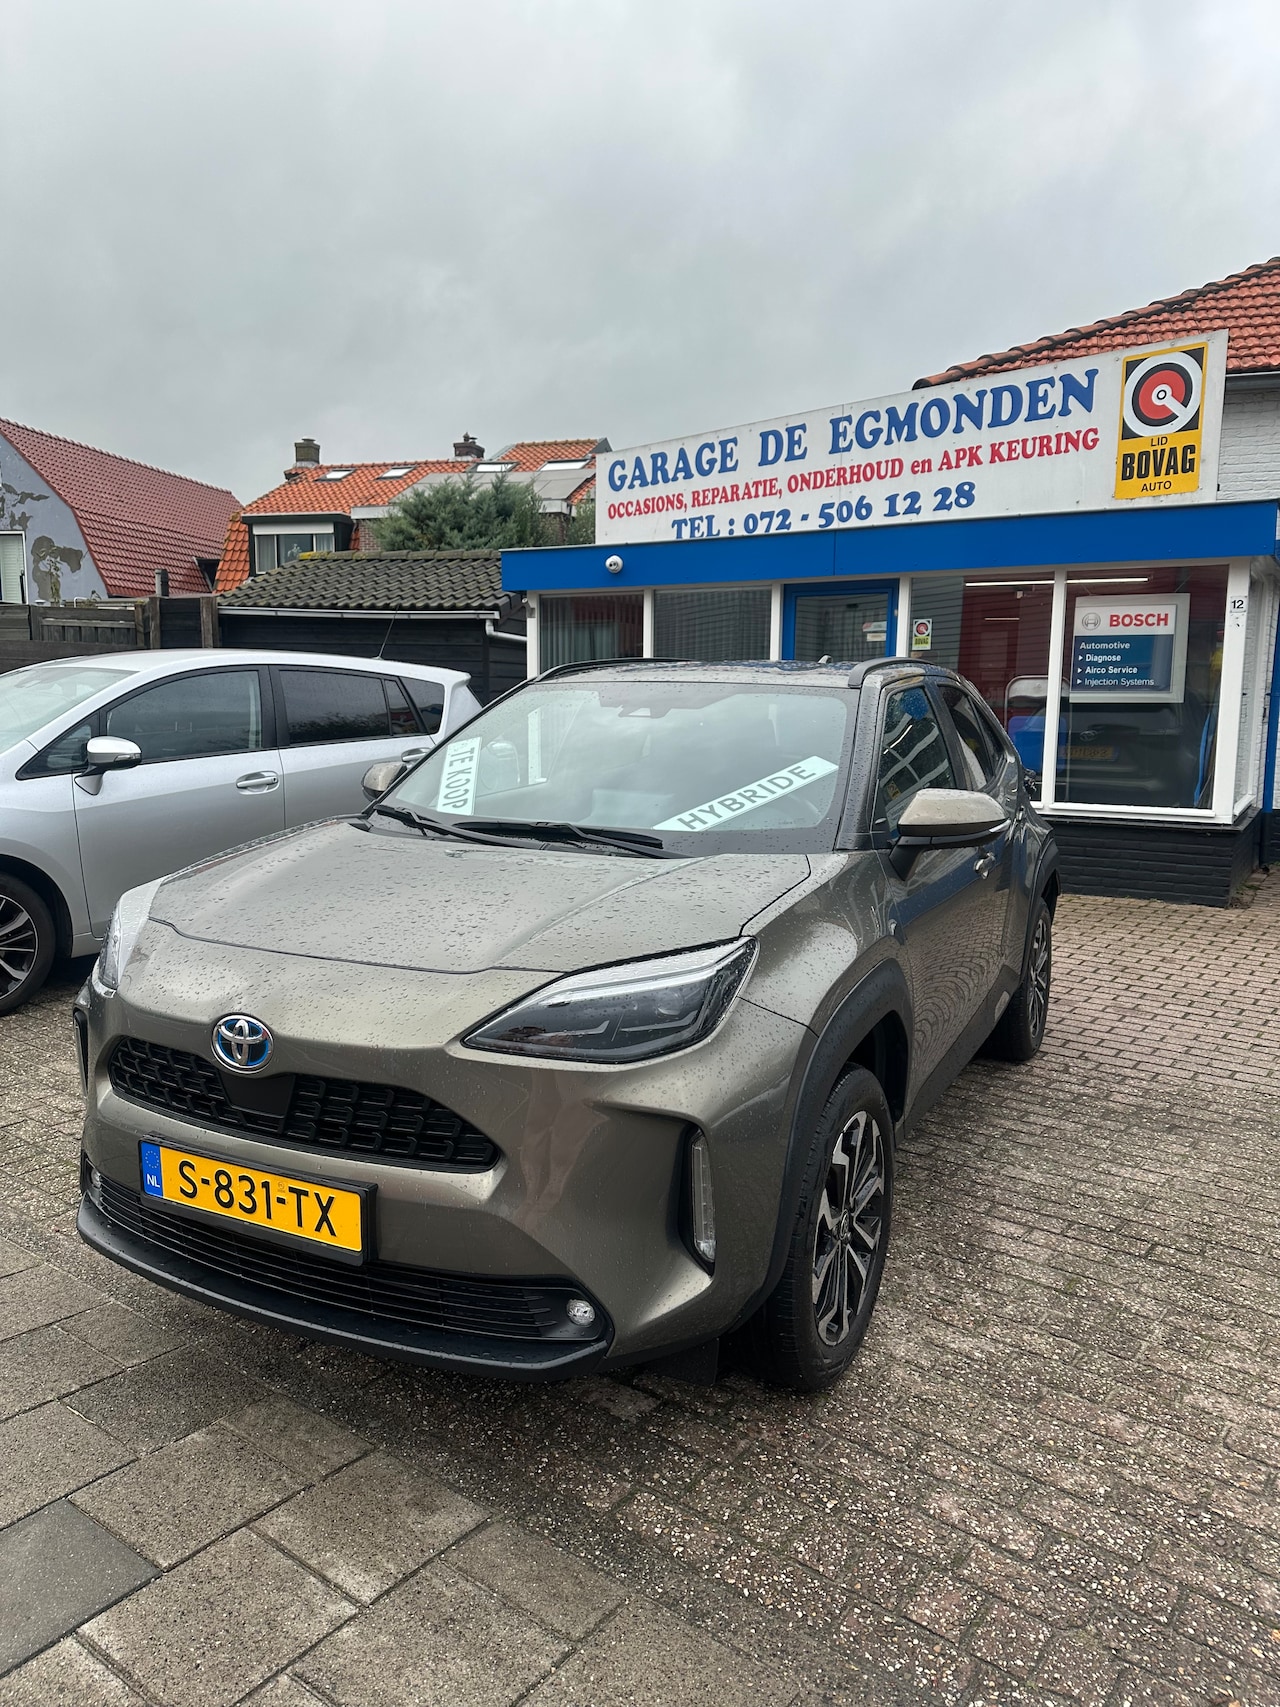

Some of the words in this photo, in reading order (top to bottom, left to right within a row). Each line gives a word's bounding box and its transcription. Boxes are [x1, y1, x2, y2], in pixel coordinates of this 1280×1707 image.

[608, 436, 739, 492] GARAGE
[758, 423, 808, 467] DE
[828, 368, 1099, 454] EGMONDEN
[1150, 436, 1168, 447] LID
[1121, 444, 1196, 481] BOVAG
[607, 493, 688, 520] OCCASIONS,
[691, 477, 783, 508] REPARATIE,
[787, 457, 904, 493] ONDERHOUD
[910, 456, 933, 475] en
[938, 445, 984, 471] APK
[989, 427, 1100, 464] KEURING
[1141, 480, 1172, 493] AUTO
[743, 508, 792, 535] 072
[818, 495, 873, 529] 506
[883, 490, 922, 517] 12
[933, 481, 976, 512] 28
[1231, 599, 1244, 609] 12
[1109, 613, 1169, 628] BOSCH
[1079, 641, 1131, 650] Automotive
[1085, 654, 1122, 663] Diagnose
[1085, 666, 1106, 674] Airco
[1107, 665, 1138, 674] Service
[1084, 678, 1119, 687] Injection
[1120, 677, 1155, 687] Systems
[448, 746, 476, 768] TE
[676, 765, 817, 831] HYBRIDE
[146, 1173, 161, 1188] NL
[178, 1160, 337, 1237] S-831-TX
